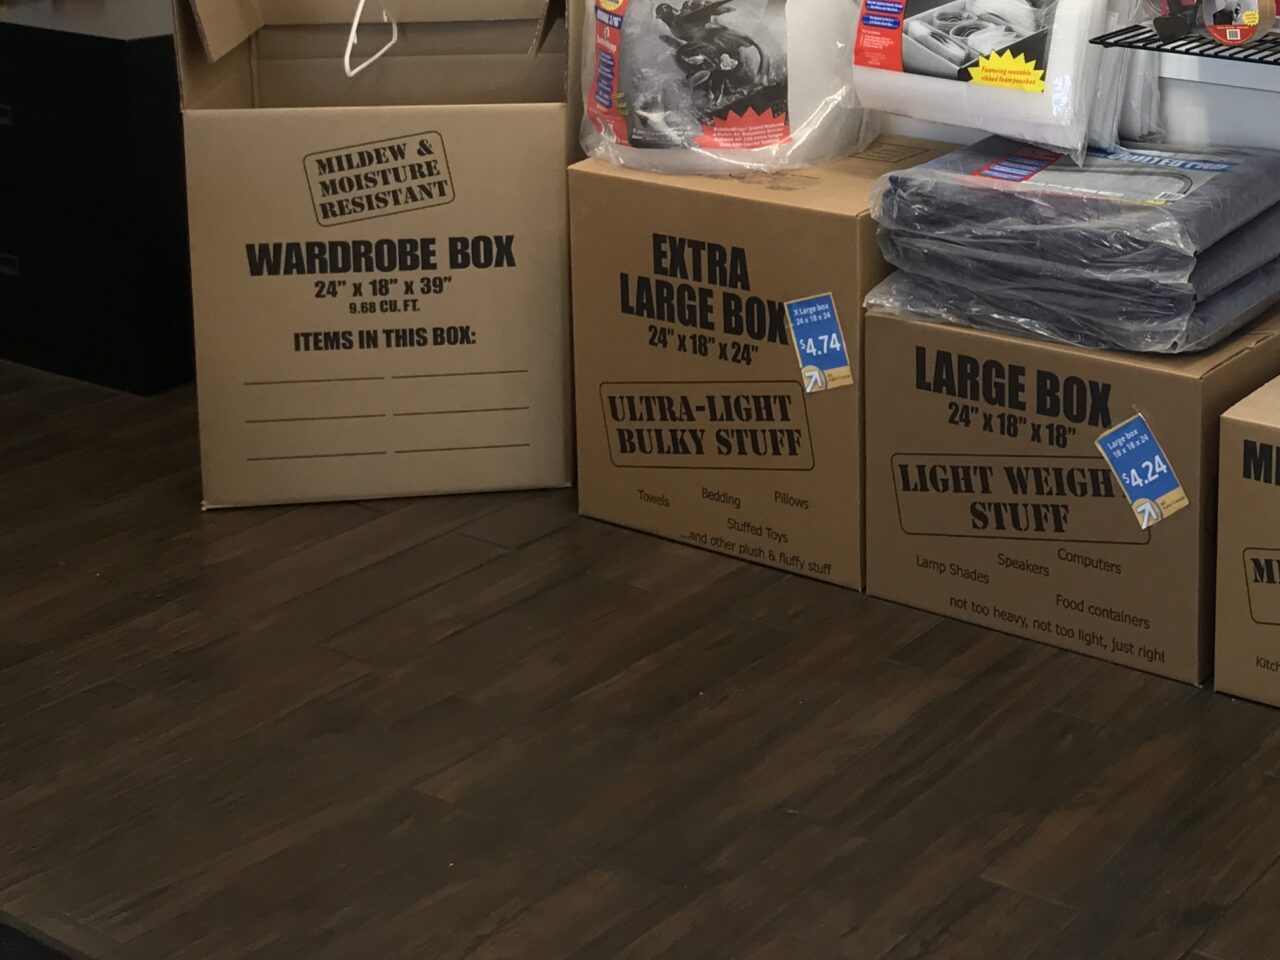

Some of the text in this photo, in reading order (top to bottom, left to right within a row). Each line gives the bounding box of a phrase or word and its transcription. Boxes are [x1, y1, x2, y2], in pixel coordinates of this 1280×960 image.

[315, 139, 434, 175] MILDEW &
[318, 159, 440, 197] MOISTURE
[319, 180, 448, 219] RESISTANT
[246, 235, 516, 276] WARDROBE BOX
[652, 233, 750, 291] EXTRA
[349, 299, 420, 314] 9.68 CU. FT.
[620, 273, 789, 345] LARGE BOX
[799, 305, 817, 316] Large
[817, 302, 829, 311] box
[294, 326, 476, 352] ITEMS IN THIS BOX:
[800, 332, 841, 357] $4.74
[915, 346, 1112, 428] LARGE BOX
[608, 395, 792, 423] ULTRA-LIGHT
[616, 428, 802, 457] BULKY STUFF
[898, 464, 1126, 499] LIGHT WEIGH
[1122, 455, 1167, 488] $4.24
[638, 489, 670, 507] Towels
[701, 487, 741, 509] Bedding
[774, 491, 809, 510] Pillows
[970, 502, 1070, 533] STUFF
[998, 553, 1049, 577] Speakers
[1057, 548, 1122, 575] Computers
